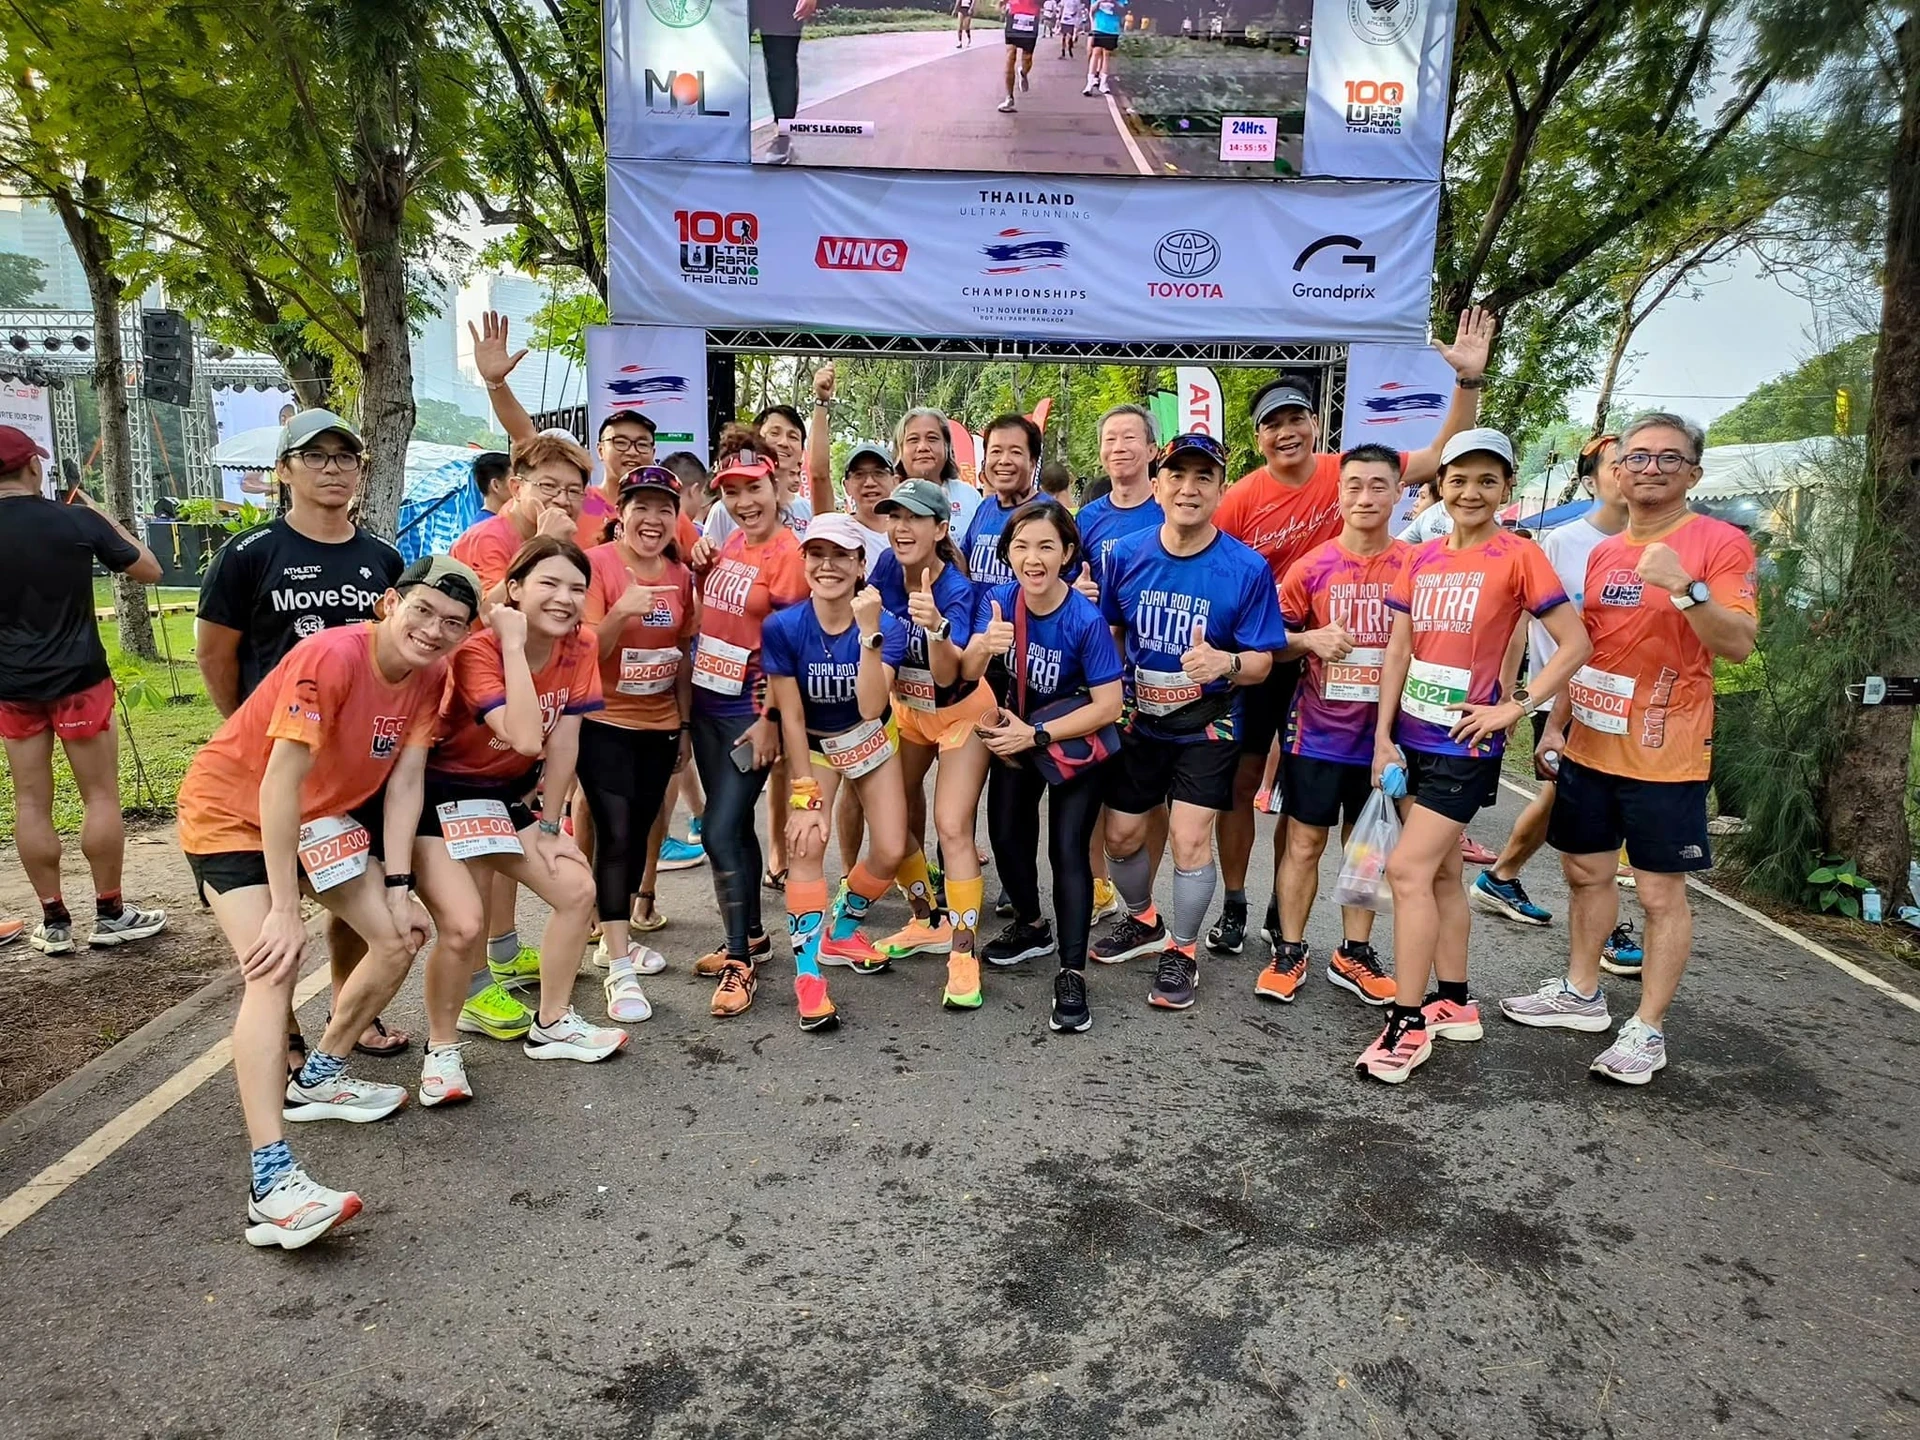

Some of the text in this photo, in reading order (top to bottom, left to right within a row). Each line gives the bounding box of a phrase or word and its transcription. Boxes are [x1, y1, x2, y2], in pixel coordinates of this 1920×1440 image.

[1345, 80, 1404, 105] 100
[790, 124, 863, 134] MEN'S LEADERS
[1232, 121, 1267, 134] 24Hrs.
[979, 191, 1074, 205] THAILAND
[960, 207, 1090, 219] ULTRA RUNNING
[674, 211, 759, 245] 100
[962, 287, 1087, 299] CHAMPIONSHIPS
[1147, 283, 1224, 299] TOYOTA
[1293, 283, 1376, 302] Grandprix
[284, 565, 322, 575] ATHLETIC
[704, 568, 753, 606] ULTRA
[1415, 571, 1485, 588] SUAN ROD FAI
[1330, 583, 1357, 599] SUAN
[1360, 583, 1379, 599] ROD
[1139, 589, 1211, 616] SUAN ROD FAI
[1411, 586, 1479, 622] ULTRA
[912, 624, 924, 638] FAI
[1450, 620, 1472, 634] 2022
[1028, 642, 1062, 663] ROD FAI
[695, 651, 742, 678] 25-005
[808, 662, 856, 677] SUAN ROD
[1004, 648, 1060, 687] UTRA
[1331, 667, 1380, 682] D12-0
[808, 675, 857, 698] ULTR
[1137, 686, 1198, 701] D13-005
[1569, 683, 1625, 714] D13-004
[830, 730, 886, 766] D23-003
[305, 829, 370, 867] D27-002
